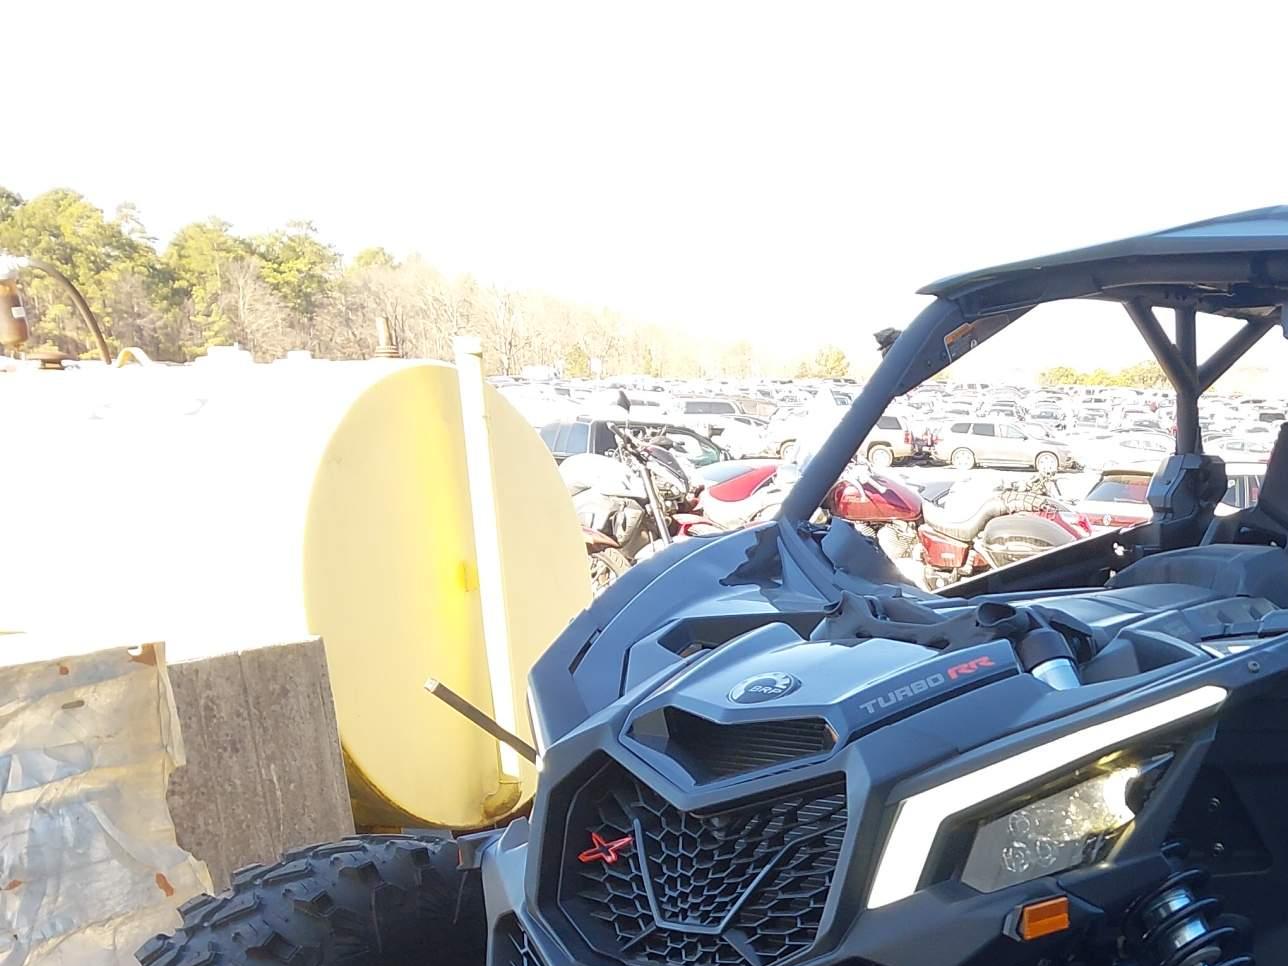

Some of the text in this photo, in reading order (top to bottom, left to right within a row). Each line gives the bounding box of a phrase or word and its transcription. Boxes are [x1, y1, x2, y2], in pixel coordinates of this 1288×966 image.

[748, 685, 783, 694] BRP
[859, 655, 995, 714] TURBO RR
